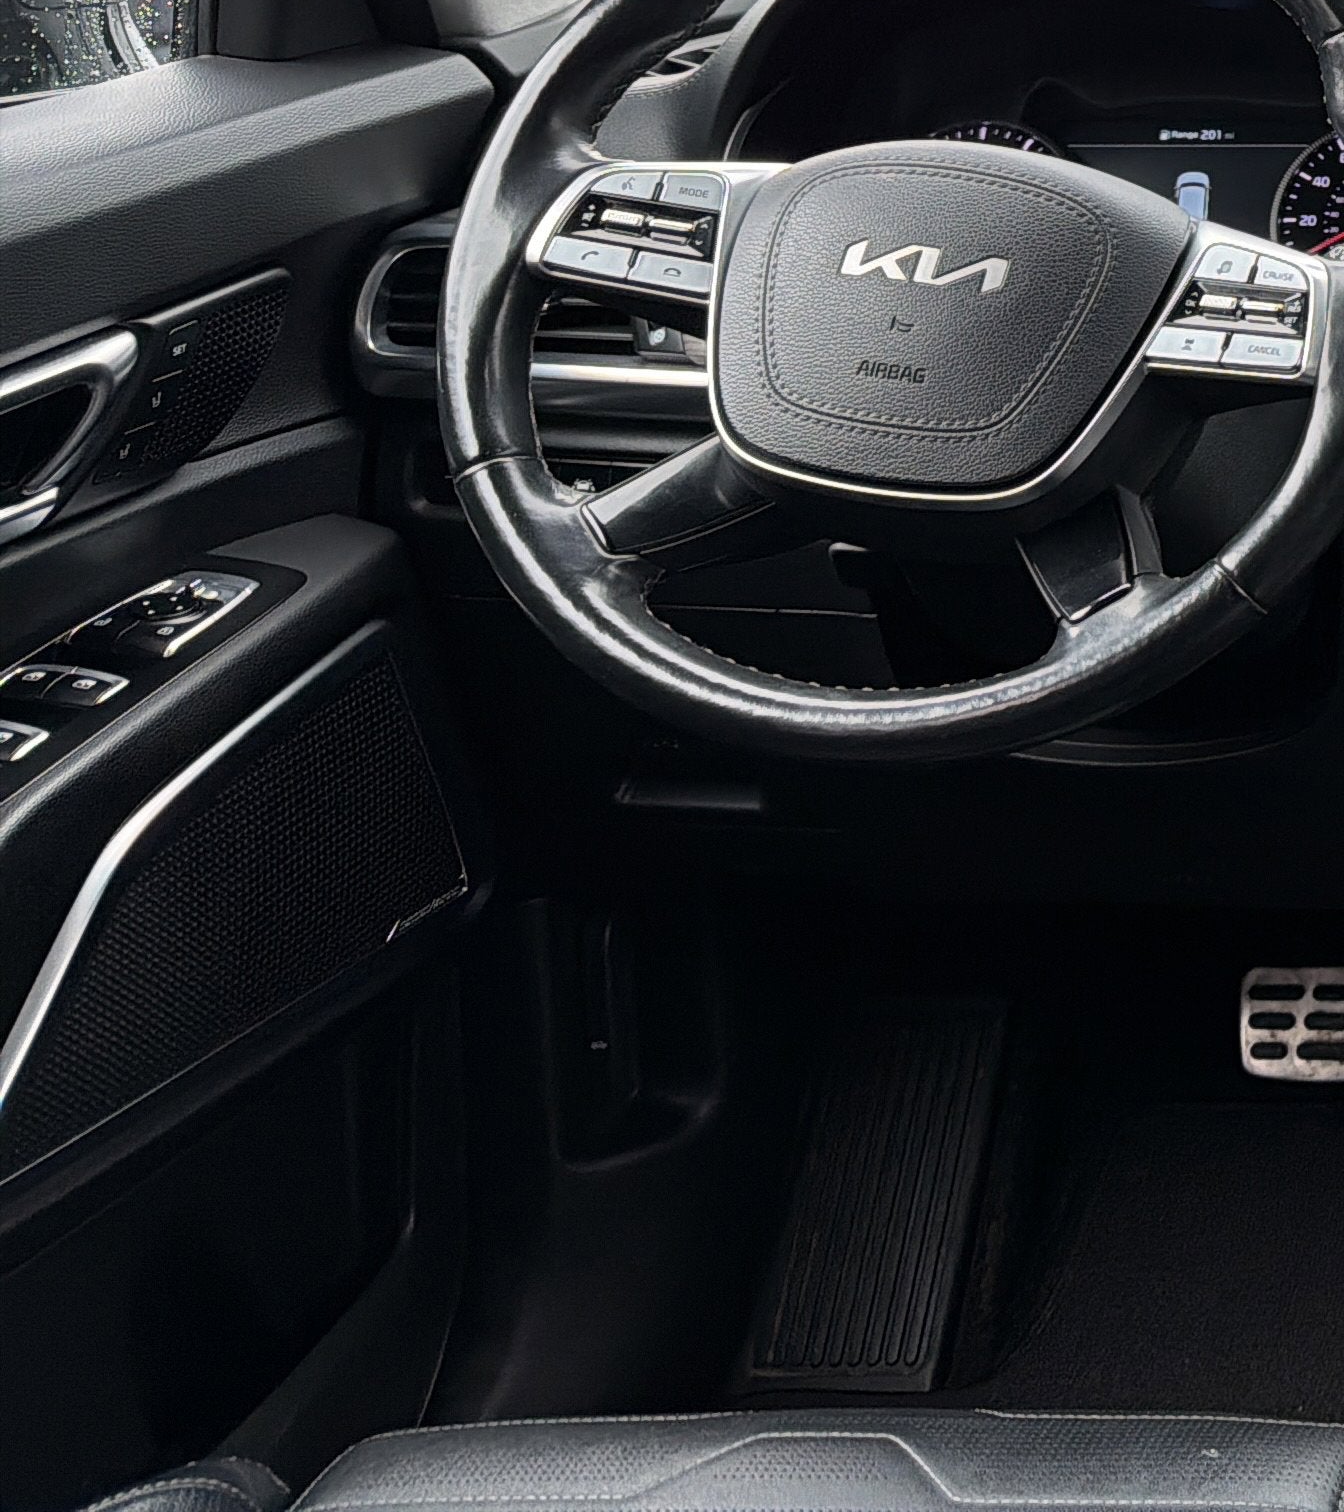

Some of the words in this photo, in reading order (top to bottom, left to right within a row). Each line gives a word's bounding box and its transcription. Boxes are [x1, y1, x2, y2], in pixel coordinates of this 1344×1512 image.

[1200, 130, 1222, 140] 201
[1312, 176, 1331, 188] 40
[678, 186, 710, 199] MODE
[1299, 215, 1318, 227] 20
[1262, 270, 1295, 281] CRUISE
[1247, 344, 1283, 356] CANCEL
[855, 358, 927, 385] AIRBAG
